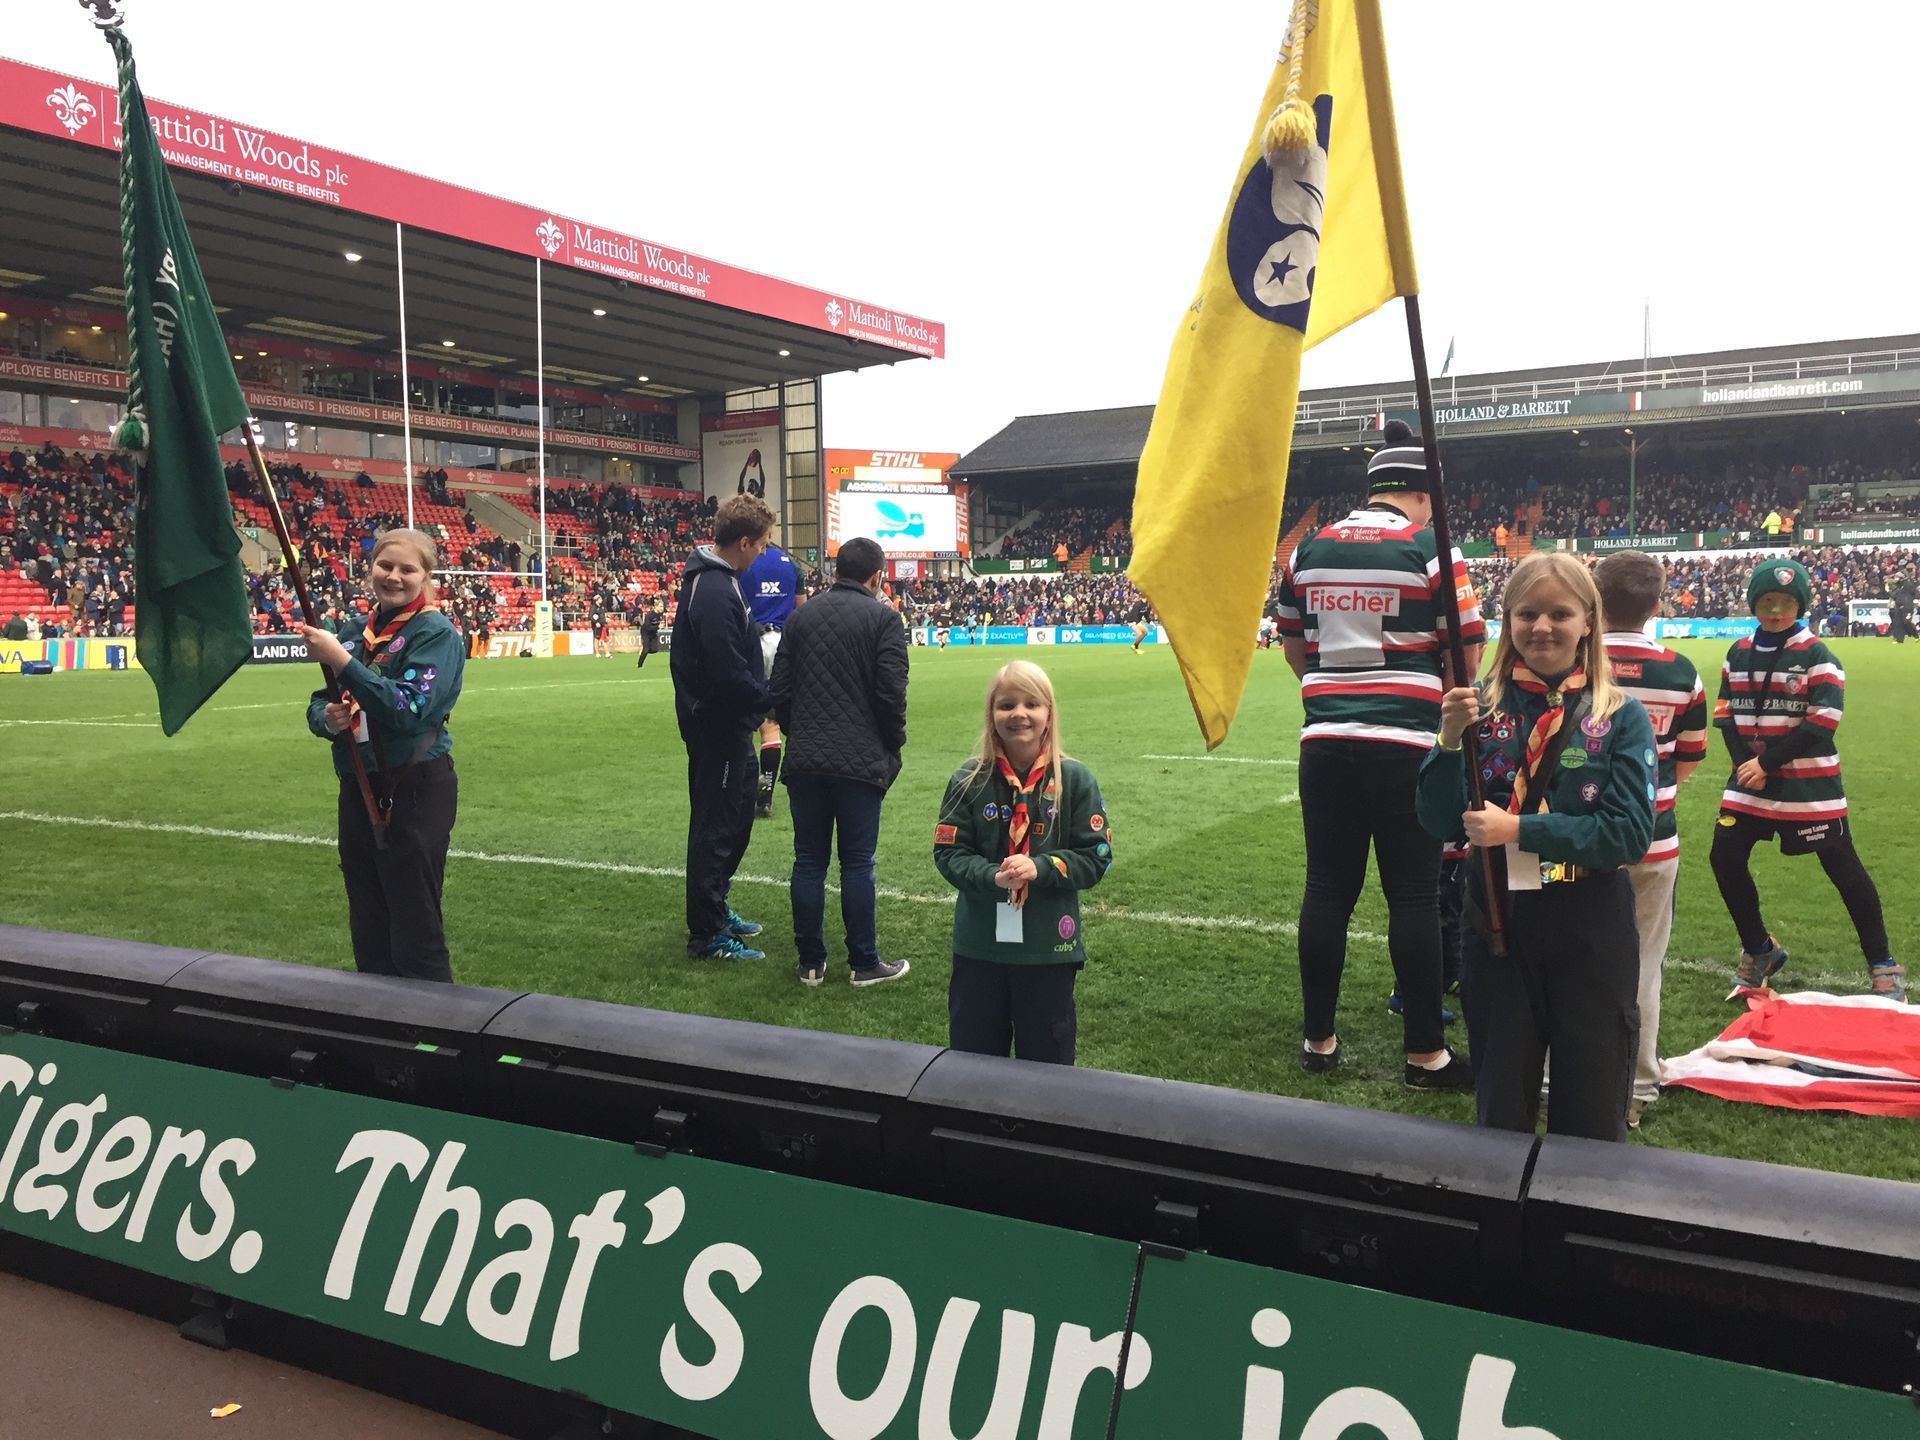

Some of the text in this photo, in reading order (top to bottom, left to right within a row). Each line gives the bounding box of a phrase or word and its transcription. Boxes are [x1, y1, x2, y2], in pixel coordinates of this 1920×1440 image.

[232, 127, 320, 178] Woods
[325, 164, 349, 186] plc
[160, 148, 340, 203] MANAGEMENT & EMPLOYEE BENEFITS
[574, 224, 710, 285] Mattioli Woods plc
[574, 256, 600, 270] WEALTH
[600, 262, 643, 282] MANAGEMENT
[649, 275, 680, 292] EMPLOYEE
[849, 302, 891, 331] Mattioli
[894, 315, 928, 341] Woods
[54, 368, 110, 385] BENEFITS
[1703, 379, 1863, 403] hollandandbarrett.com
[250, 392, 315, 411] INVESTMENTS
[327, 403, 370, 418] PENSIONS
[382, 410, 424, 425] EMPLYEE
[425, 417, 462, 430] BENEFITS
[472, 422, 509, 436] FINANCIAL
[555, 434, 599, 447] INVESTMENTS
[606, 439, 636, 451] PENSIONS
[1435, 400, 1571, 423] HOLLAND & BARRETT
[869, 452, 924, 467] STIHL
[1594, 539, 1631, 549] HOLLAND
[1642, 536, 1677, 546] BARRETT
[761, 581, 780, 593] DX
[1310, 590, 1394, 613] Fischer
[1857, 608, 1872, 616] DX
[1061, 630, 1082, 642] DX
[1662, 623, 1692, 638] DX
[253, 645, 288, 659] LAND
[324, 1130, 762, 1401] That's
[809, 1275, 1152, 1440] our
